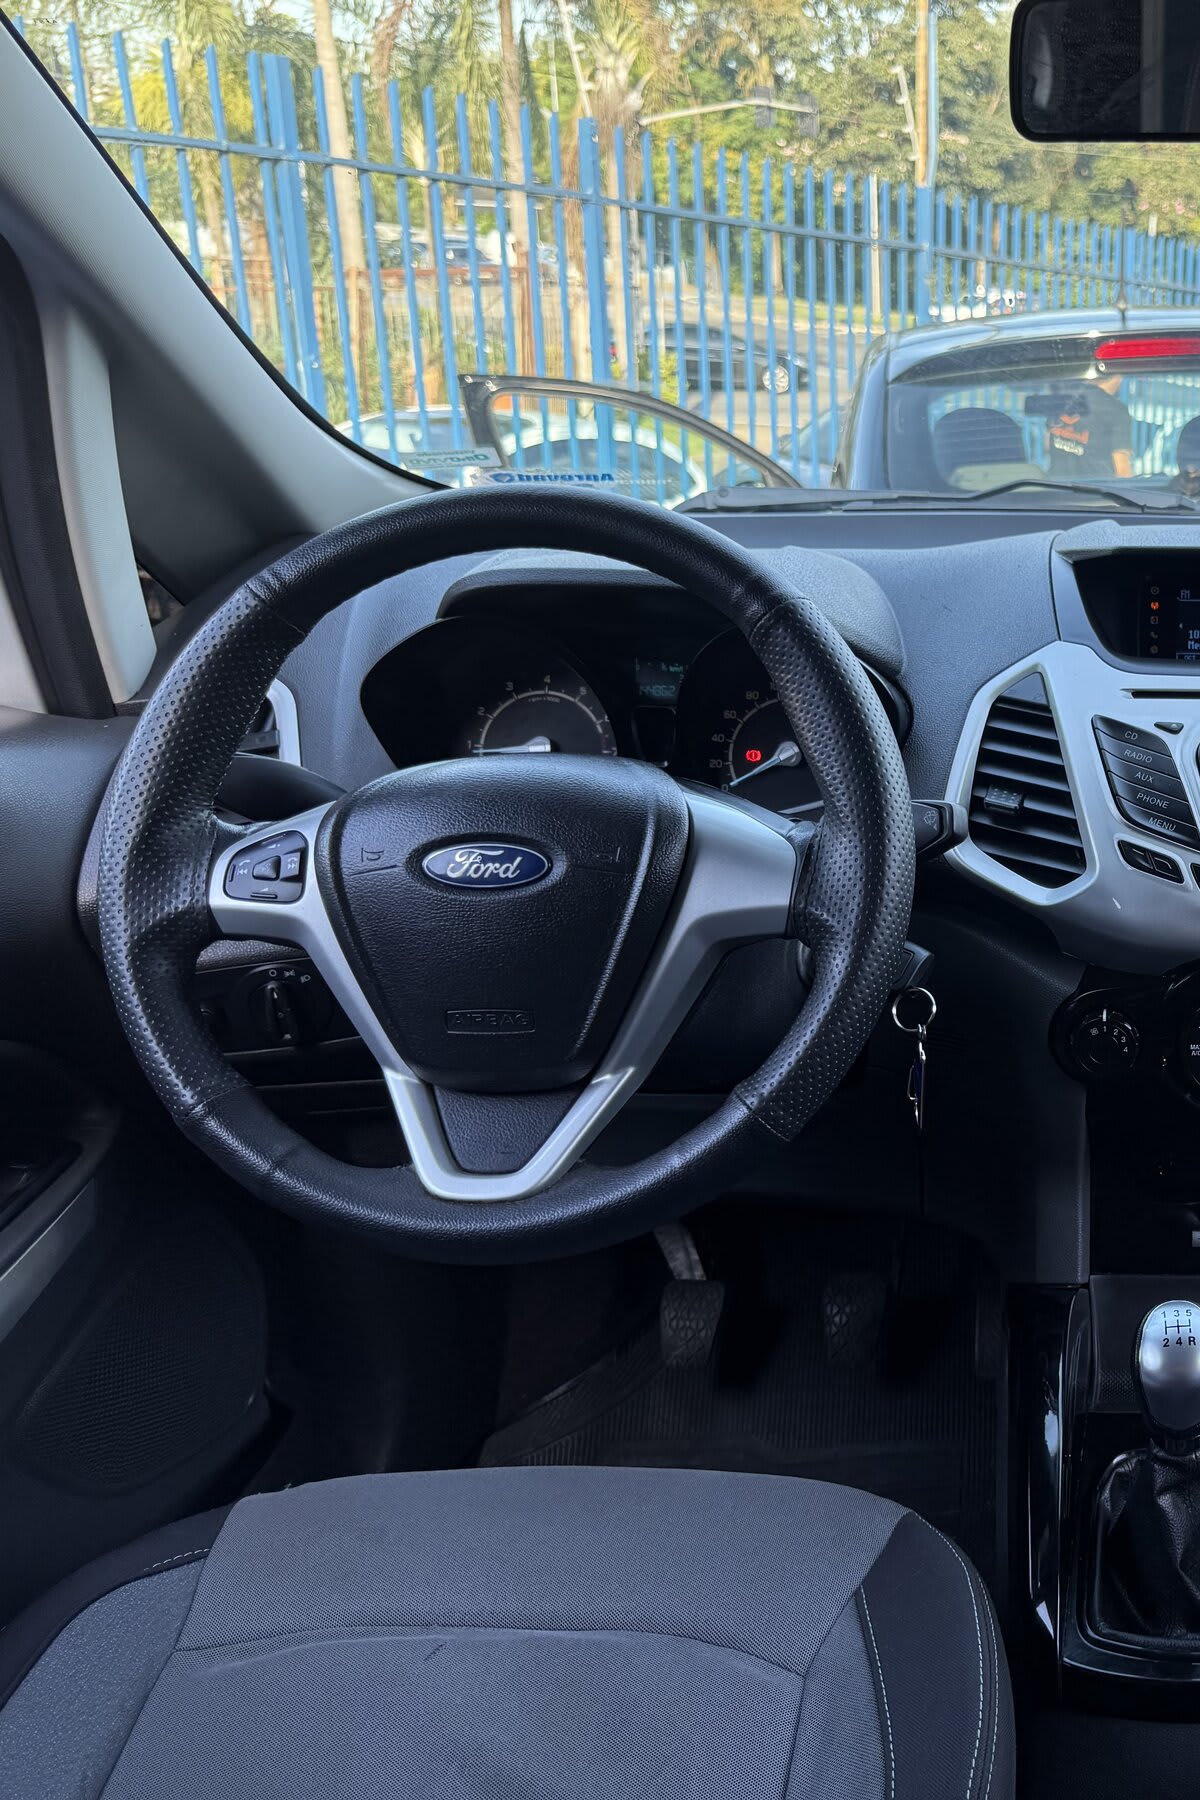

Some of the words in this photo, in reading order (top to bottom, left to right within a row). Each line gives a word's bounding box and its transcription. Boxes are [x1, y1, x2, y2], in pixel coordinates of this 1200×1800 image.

[1180, 590, 1190, 599] FM
[745, 691, 760, 700] 80
[723, 710, 737, 719] 60
[711, 734, 725, 743] 40
[1124, 731, 1138, 741] CD
[1124, 749, 1152, 763] RADIO
[709, 759, 723, 768] 20
[1134, 771, 1154, 783] AUX
[1136, 792, 1170, 809] PHONE
[1148, 817, 1177, 832] MENU
[447, 848, 523, 879] Ford
[1173, 1309, 1180, 1317] 3
[1186, 1309, 1192, 1317] 5
[1162, 1338, 1170, 1347] 2
[1175, 1337, 1183, 1346] 4
[1188, 1336, 1196, 1346] R
